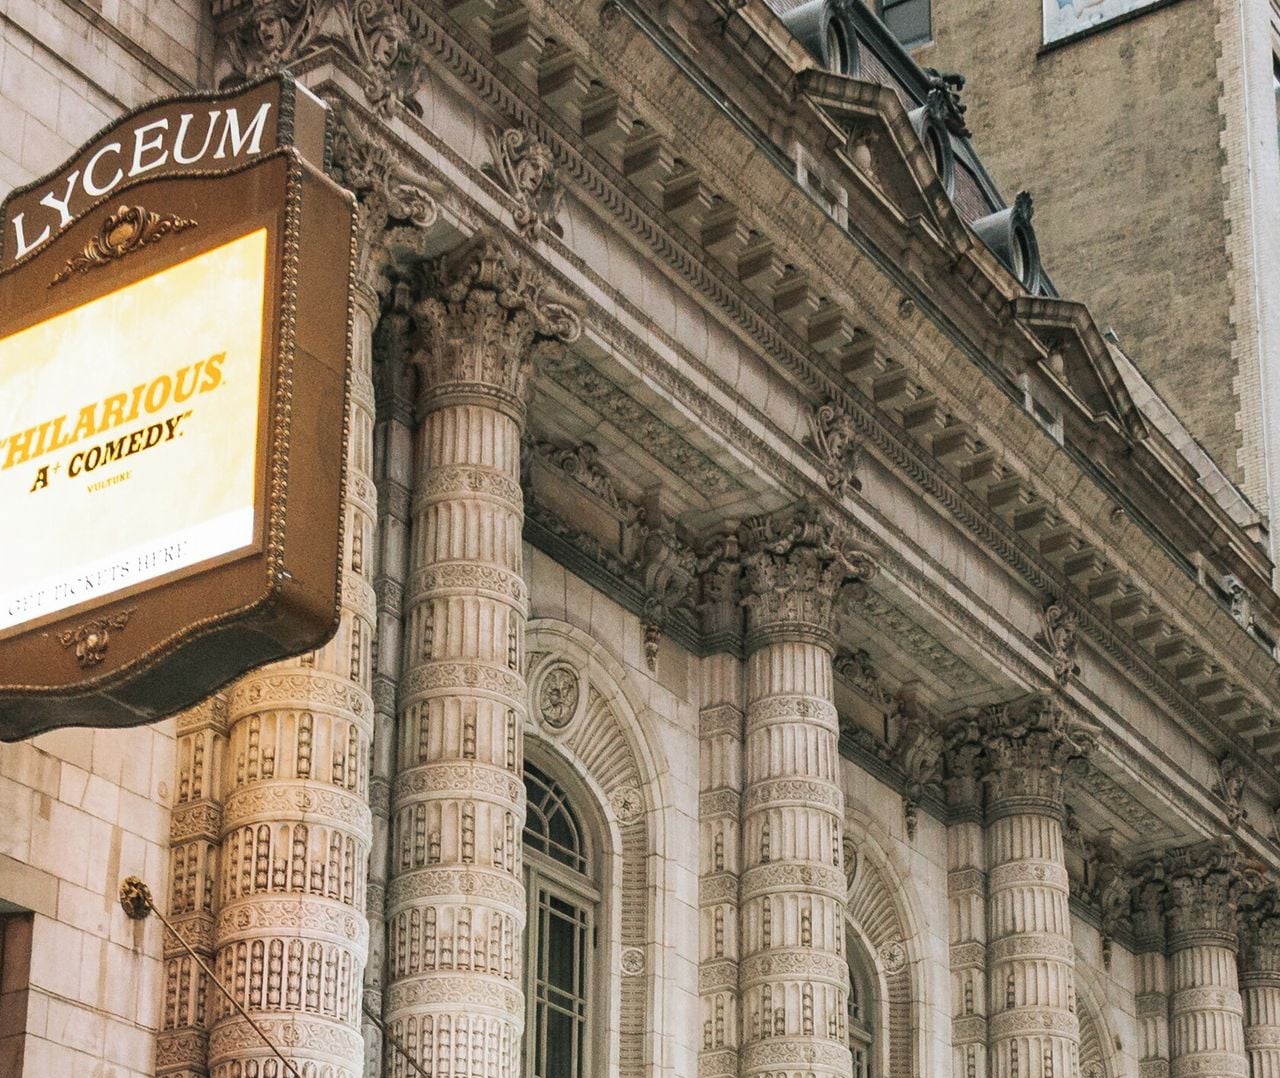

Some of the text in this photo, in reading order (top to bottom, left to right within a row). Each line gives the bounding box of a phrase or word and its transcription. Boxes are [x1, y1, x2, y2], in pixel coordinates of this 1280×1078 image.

[11, 102, 272, 260] LYCEUM
[86, 469, 133, 493] VULTURE
[8, 539, 188, 616] GET TICKETS HERE
